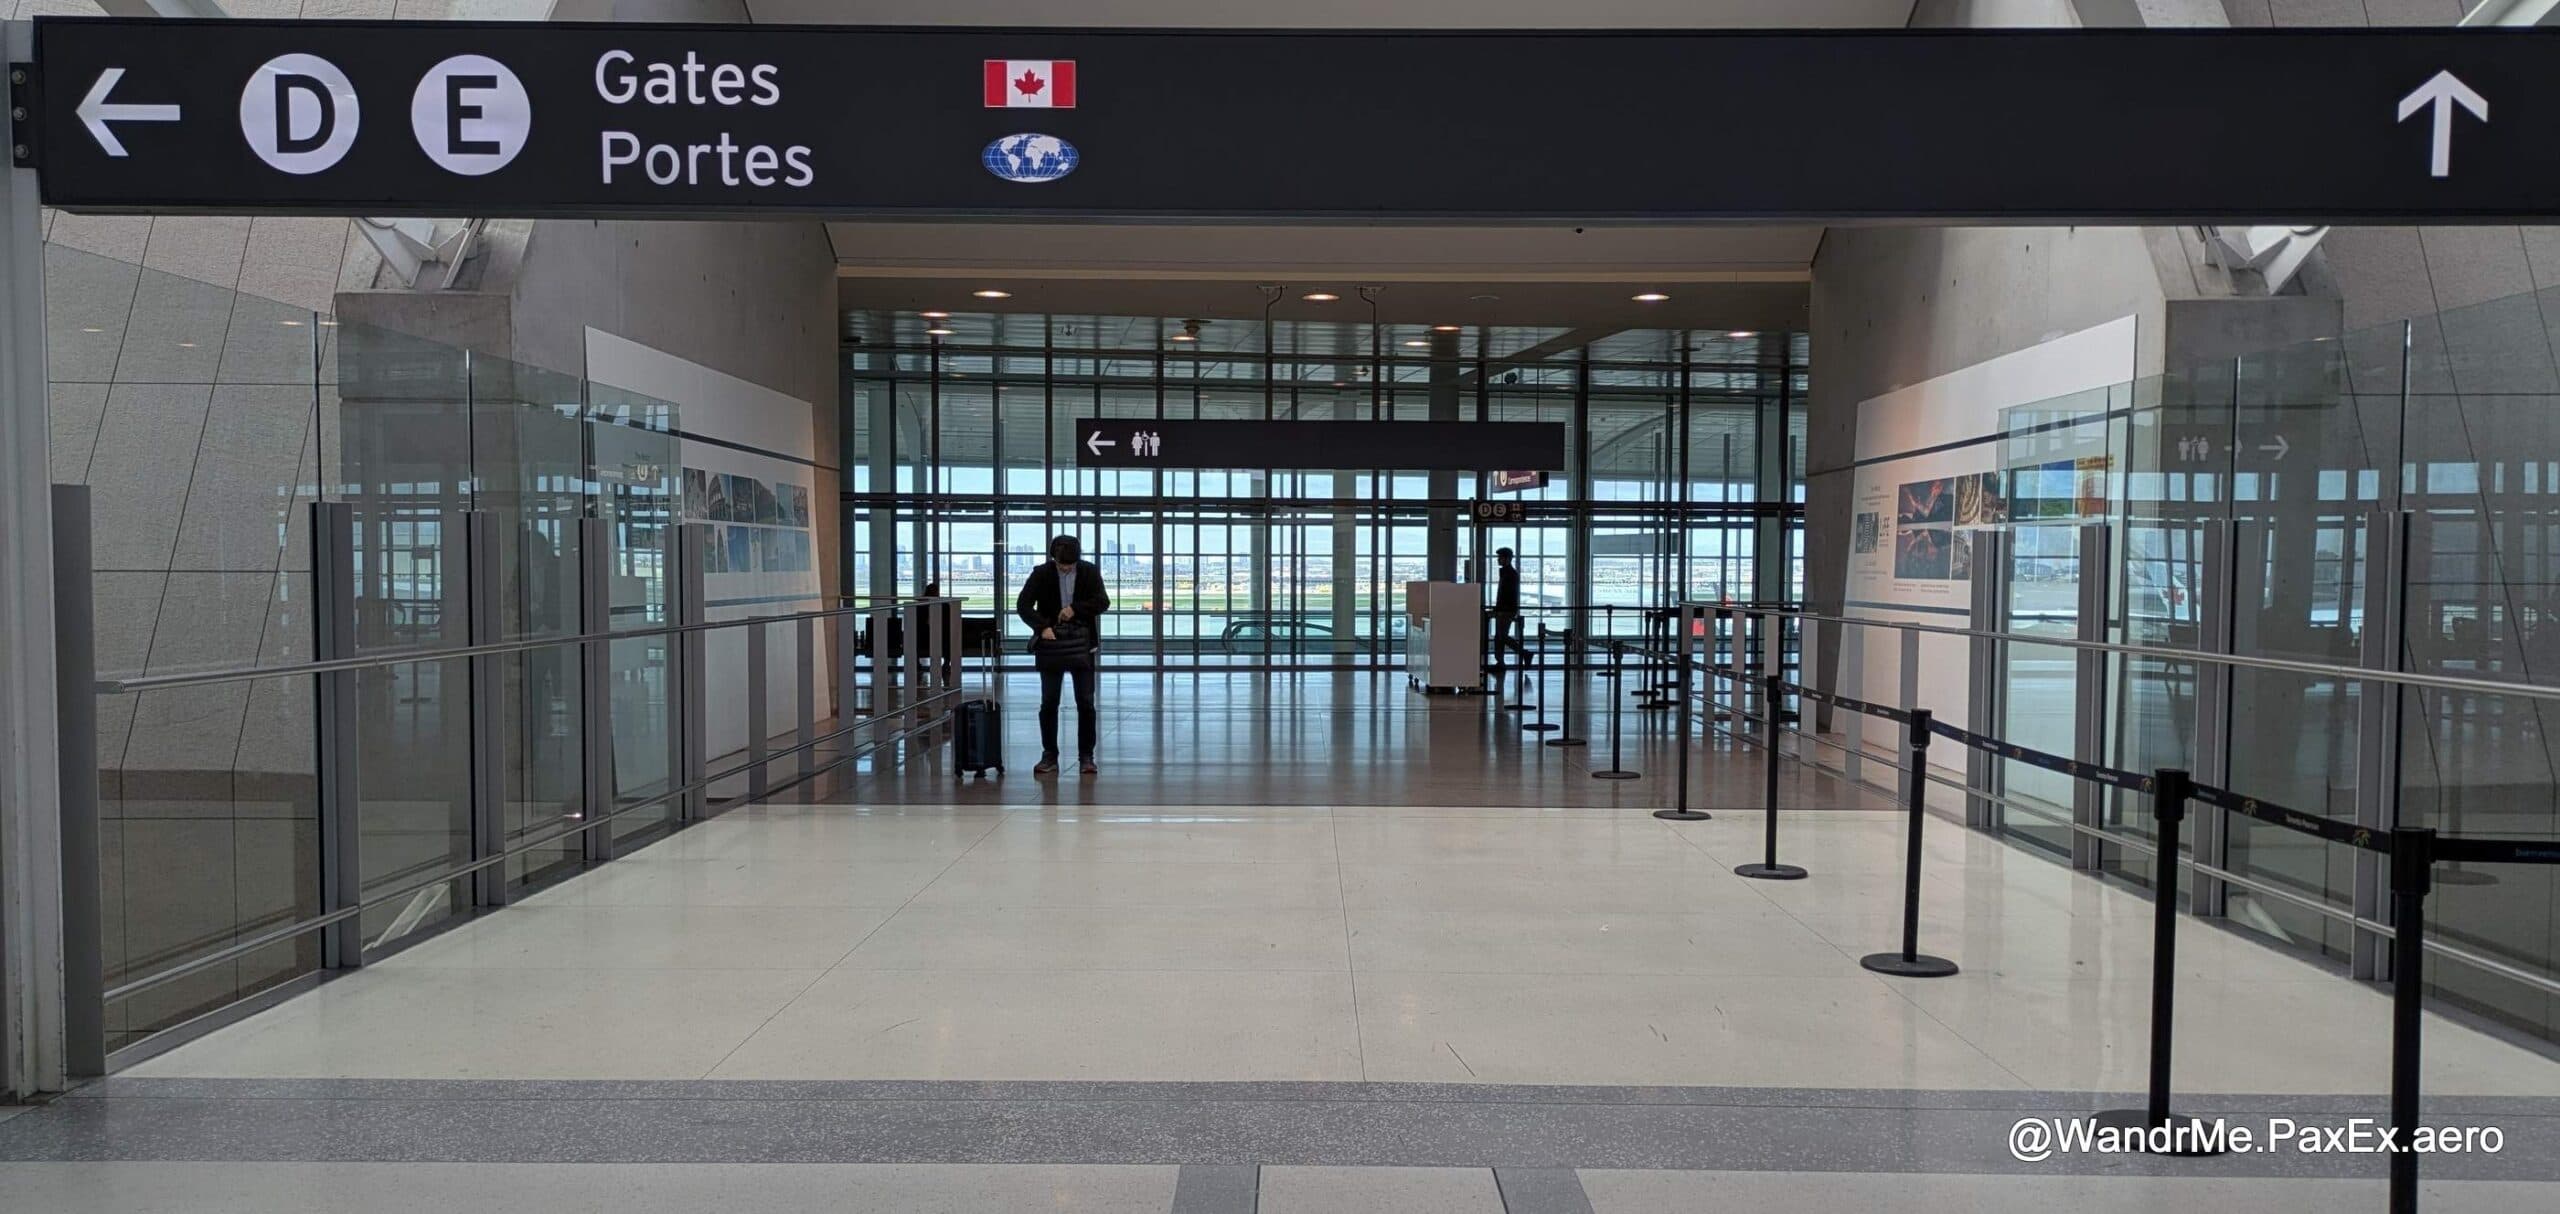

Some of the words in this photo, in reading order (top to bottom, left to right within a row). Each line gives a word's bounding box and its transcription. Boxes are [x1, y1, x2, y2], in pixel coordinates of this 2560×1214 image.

[595, 49, 780, 106] Gates
[275, 73, 335, 154] D
[446, 74, 501, 155] E
[602, 131, 814, 187] Portes
